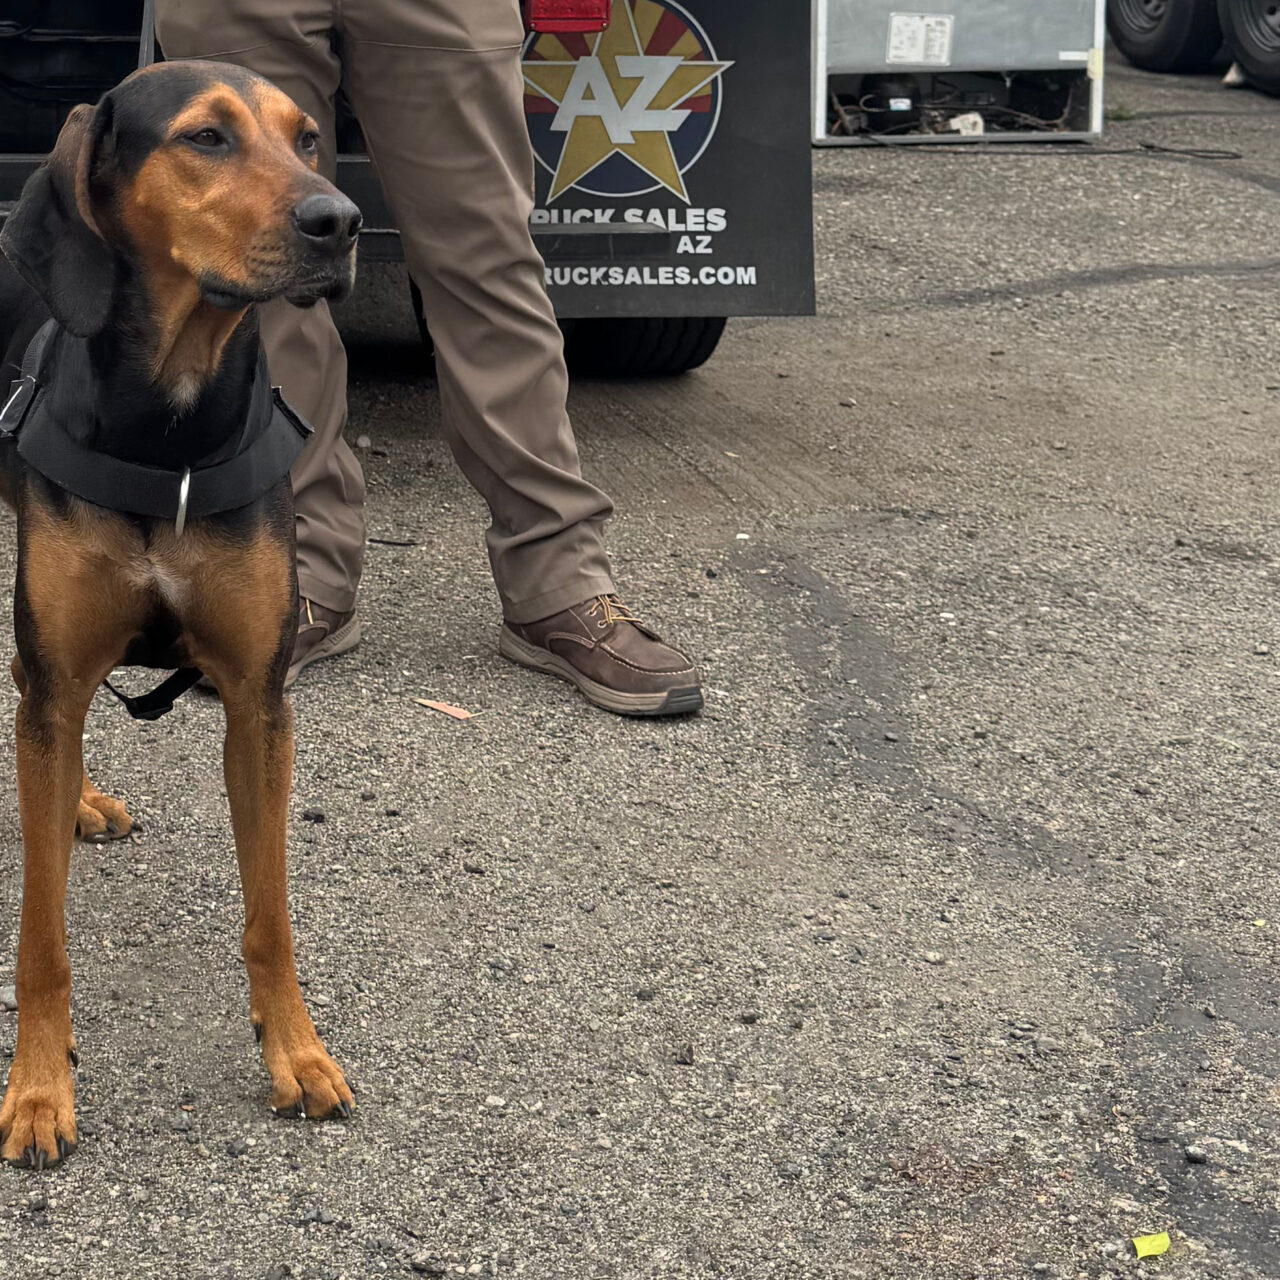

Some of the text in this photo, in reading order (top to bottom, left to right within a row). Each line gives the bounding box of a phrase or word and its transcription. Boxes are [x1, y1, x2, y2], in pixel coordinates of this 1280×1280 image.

[550, 55, 692, 144] AZ
[624, 208, 728, 232] SALES
[676, 235, 713, 254] AZ
[544, 266, 757, 286] RUCKSALES.COM
